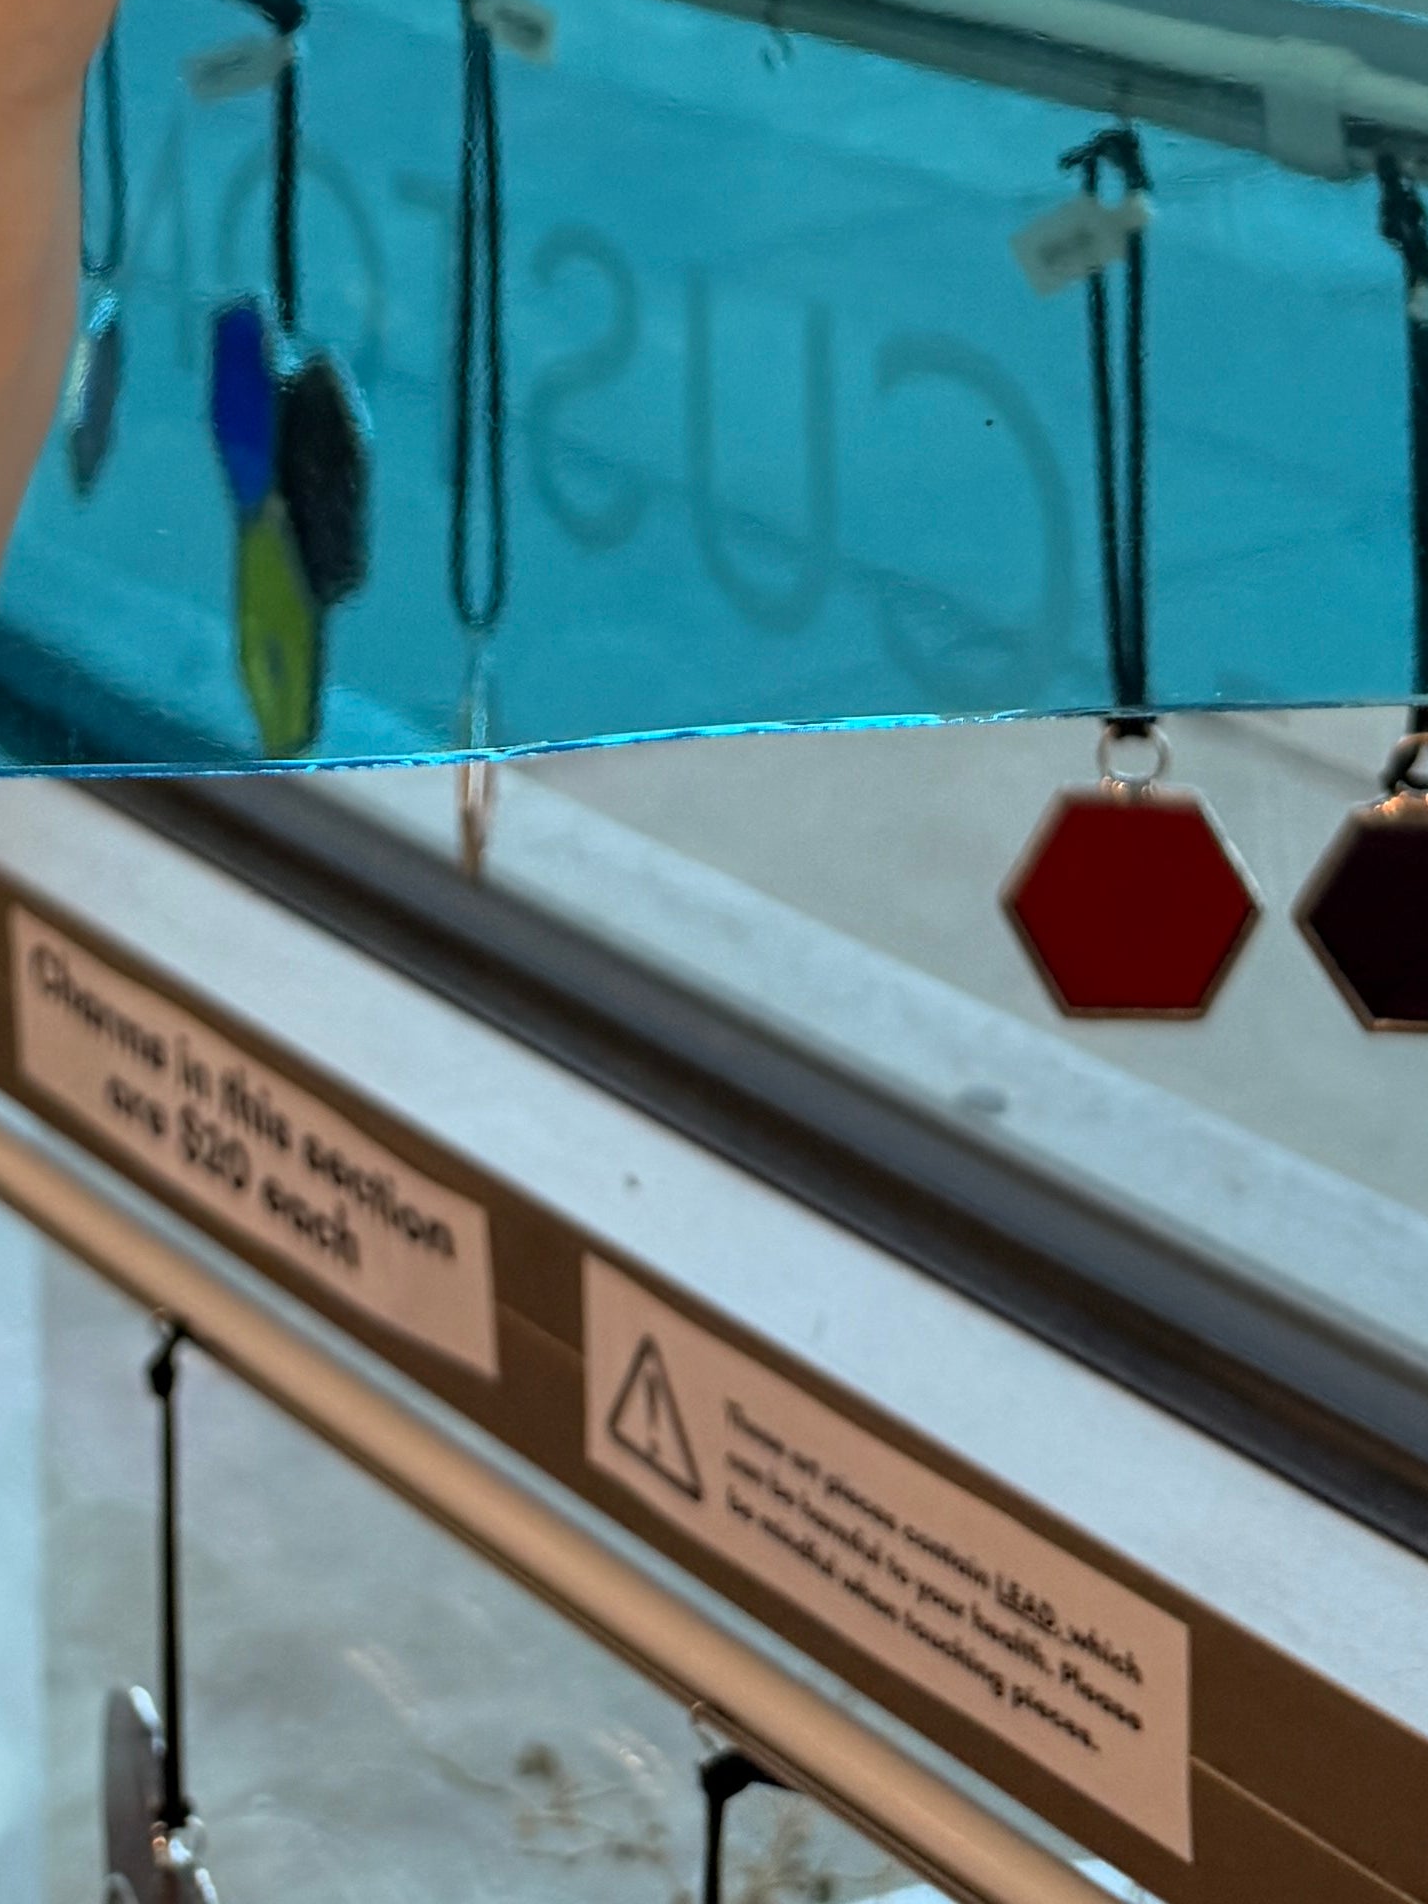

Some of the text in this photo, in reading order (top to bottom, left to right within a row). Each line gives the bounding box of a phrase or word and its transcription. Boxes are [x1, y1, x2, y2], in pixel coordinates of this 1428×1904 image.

[28, 940, 458, 1261] Charms in this section
